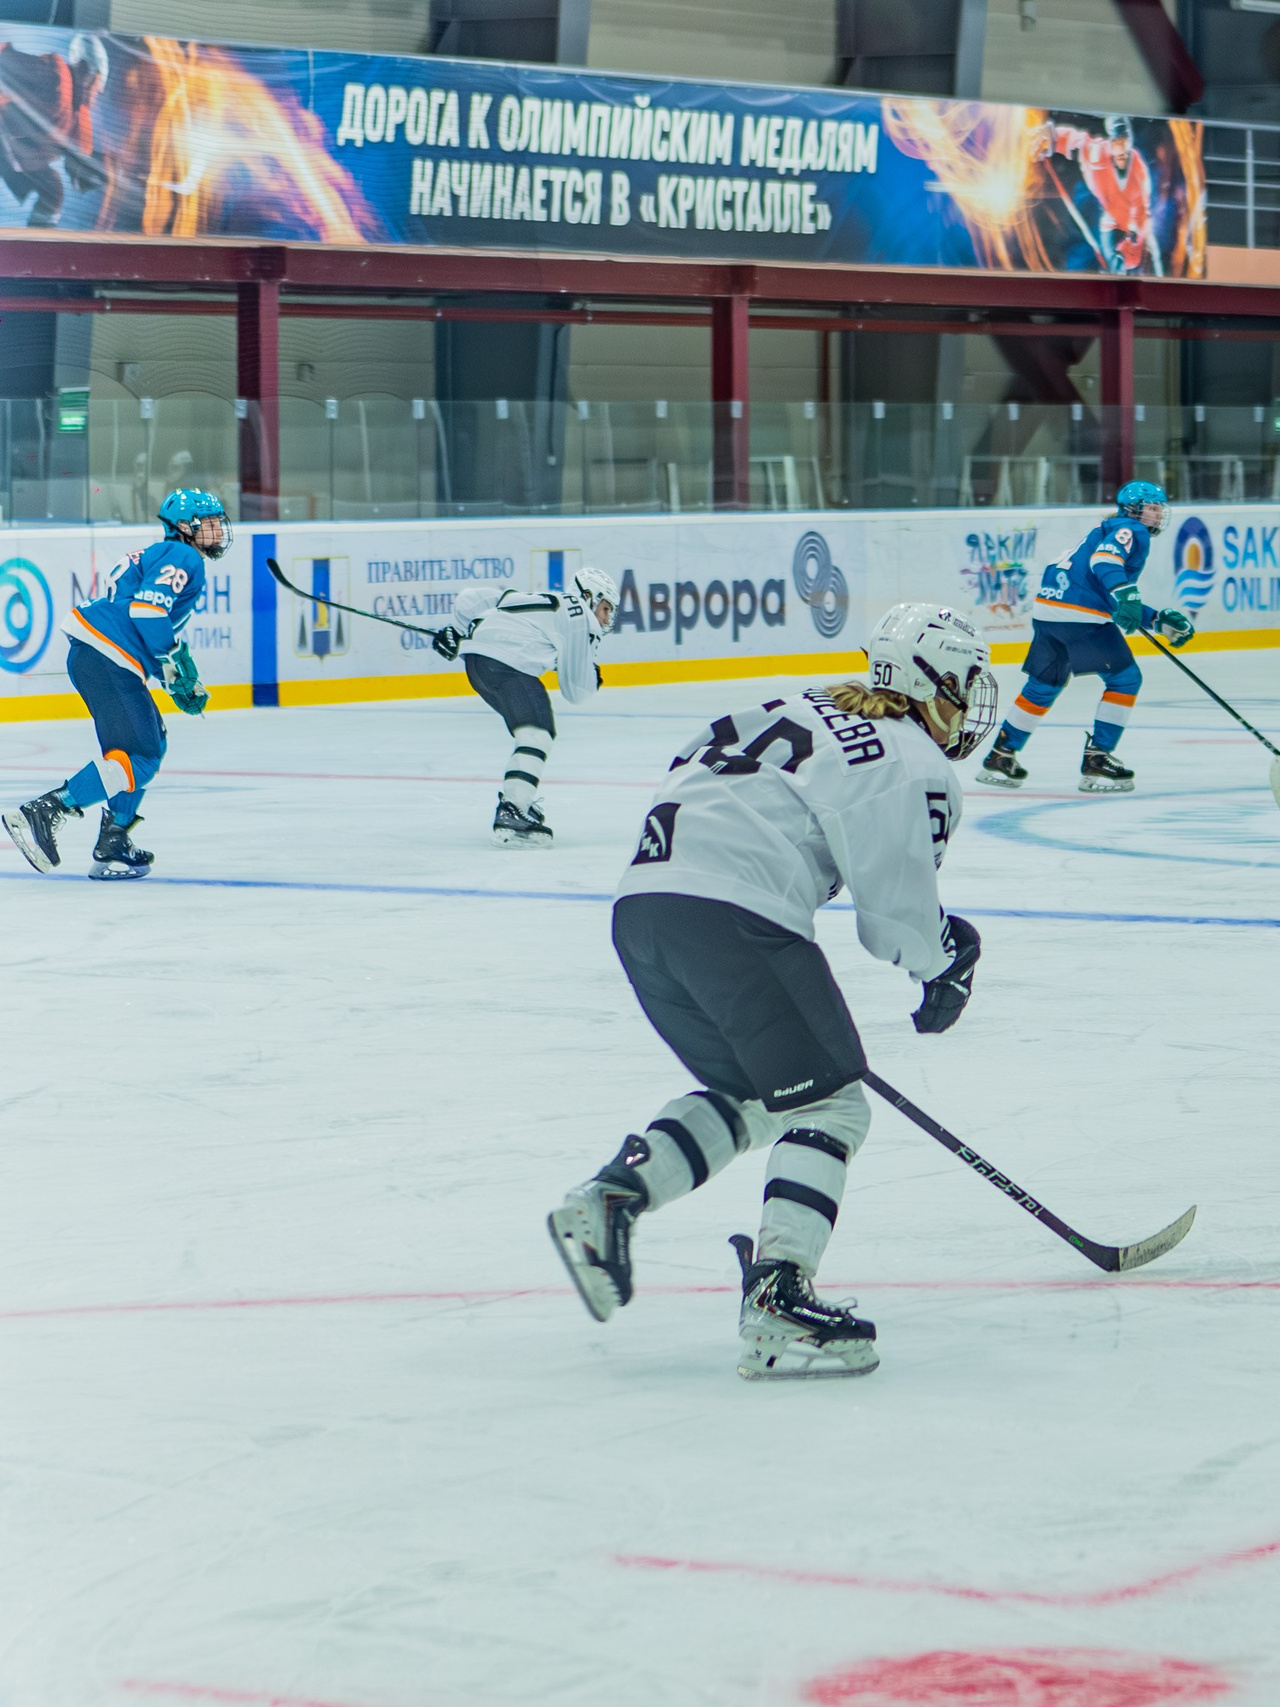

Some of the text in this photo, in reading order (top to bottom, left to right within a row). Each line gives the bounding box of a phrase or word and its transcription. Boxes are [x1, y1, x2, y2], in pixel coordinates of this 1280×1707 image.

[337, 82, 879, 176] ДОРОГА К ОЛИМПИЙСКИМ МЕДАЛЯМ
[410, 157, 833, 234] НАЧИНАЕТСЯ В «КРИСТАЛЛЕ»
[154, 564, 188, 594] 28
[367, 557, 515, 584] ПРАВИТЕЛЬСТВО
[613, 569, 786, 645] Аврора
[873, 663, 893, 686] 50
